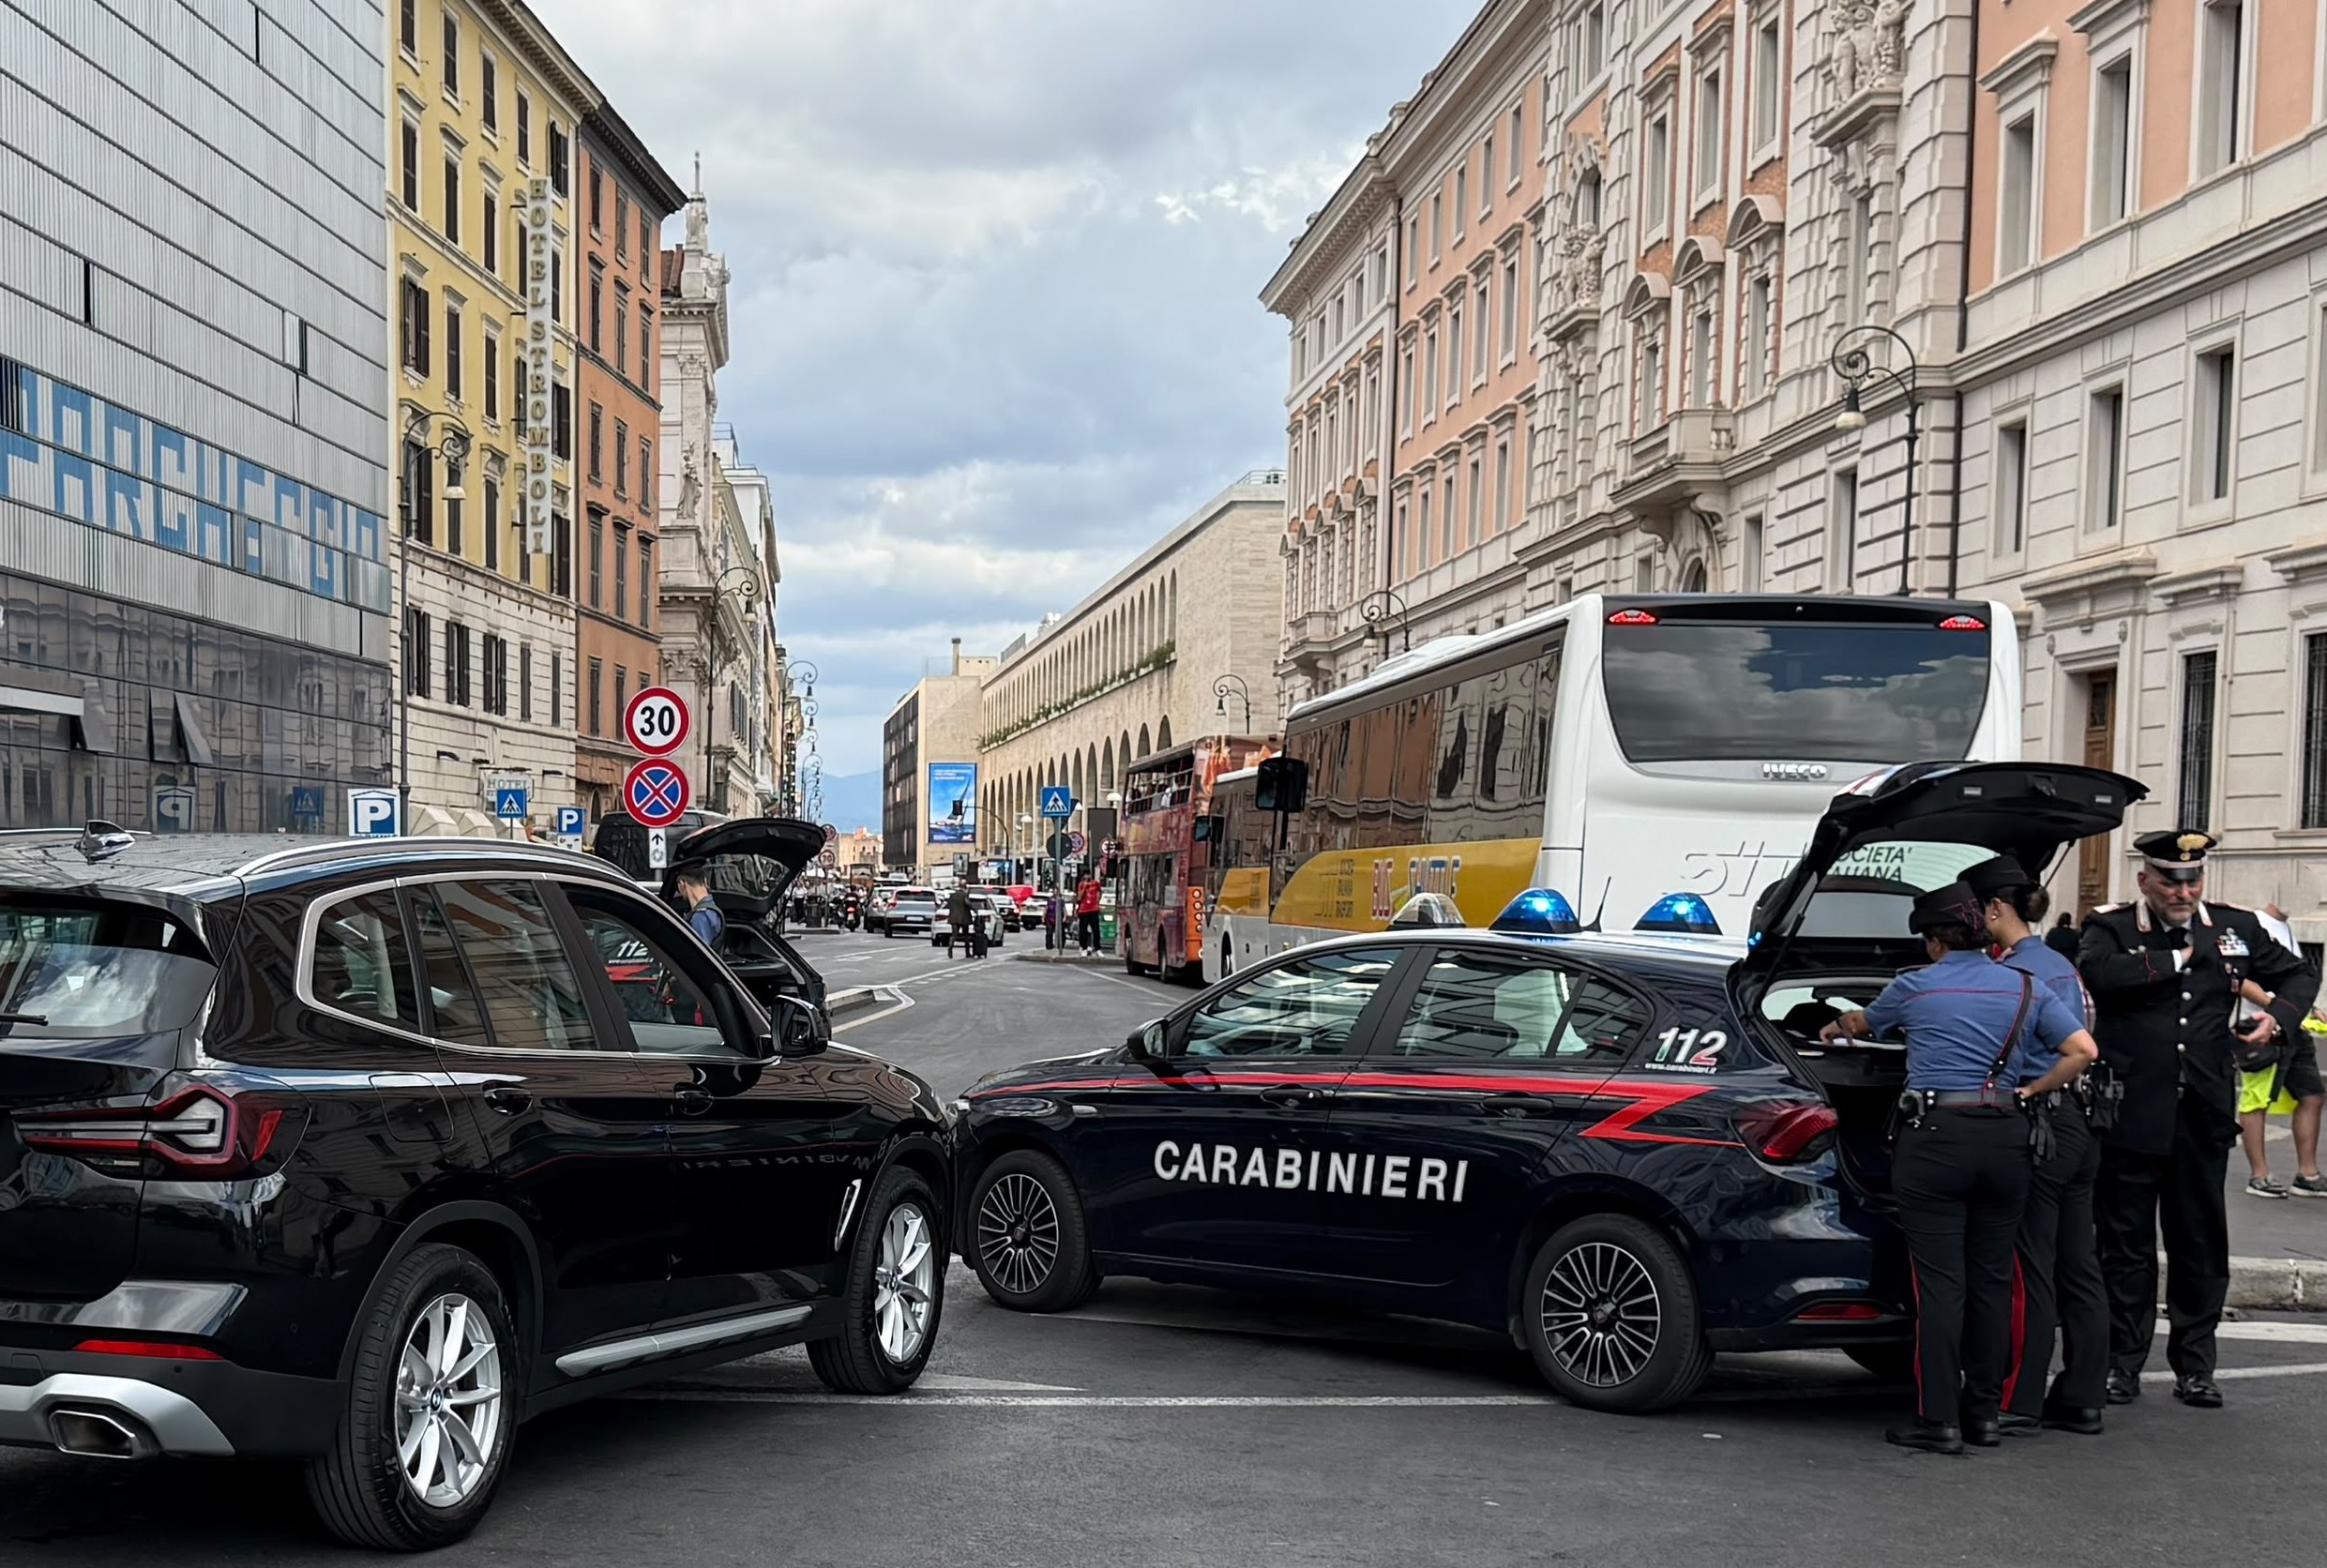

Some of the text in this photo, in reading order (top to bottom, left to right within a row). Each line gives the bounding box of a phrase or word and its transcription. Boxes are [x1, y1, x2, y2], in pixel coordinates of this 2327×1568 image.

[528, 178, 549, 553] HOTEL STROMBOLI
[640, 705, 675, 736] 30
[488, 779, 528, 788] HOTEL
[1763, 763, 1827, 779] IVECO
[356, 799, 391, 833] P
[561, 809, 579, 831] P
[617, 941, 649, 957] 112
[1655, 1027, 1727, 1066] 112
[1155, 1140, 1469, 1203] CARABINIERI
